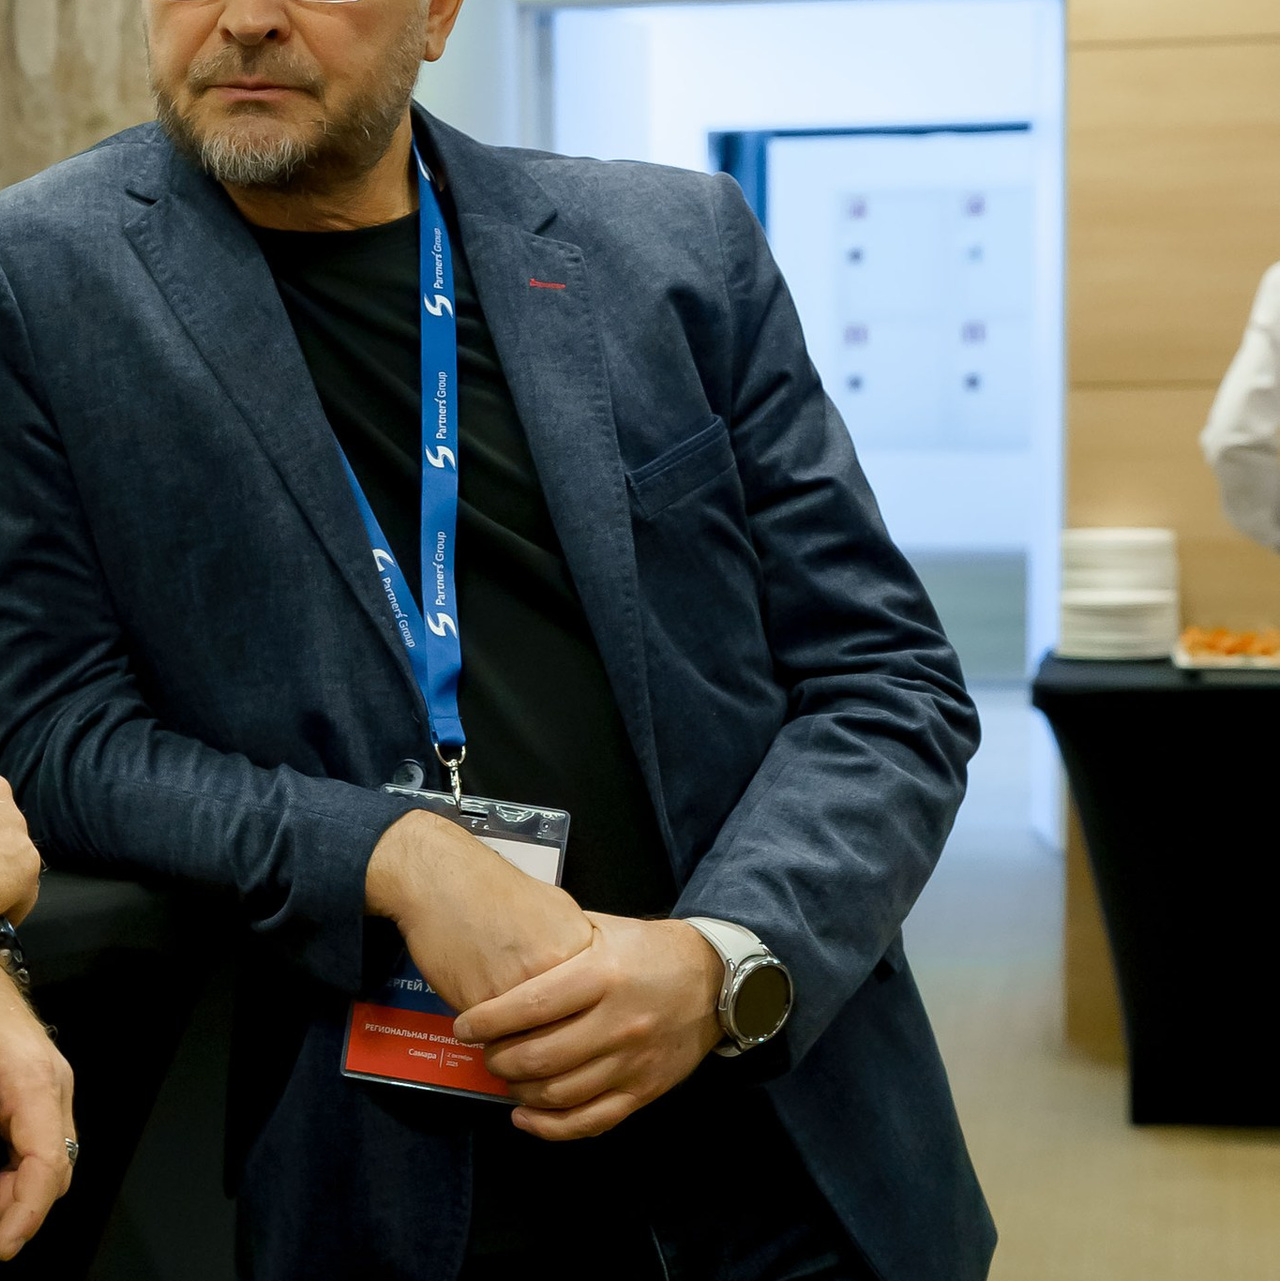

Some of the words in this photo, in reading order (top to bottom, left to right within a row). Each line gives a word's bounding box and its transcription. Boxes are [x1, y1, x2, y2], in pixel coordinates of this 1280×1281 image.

[436, 371, 448, 398] Group
[435, 531, 447, 562] Group
[398, 619, 416, 648] Group
[386, 978, 422, 991] ЕРГЕЙ
[365, 1023, 427, 1040] РЕГИОНАЛЬНАЯ
[408, 1048, 437, 1060] Самара
